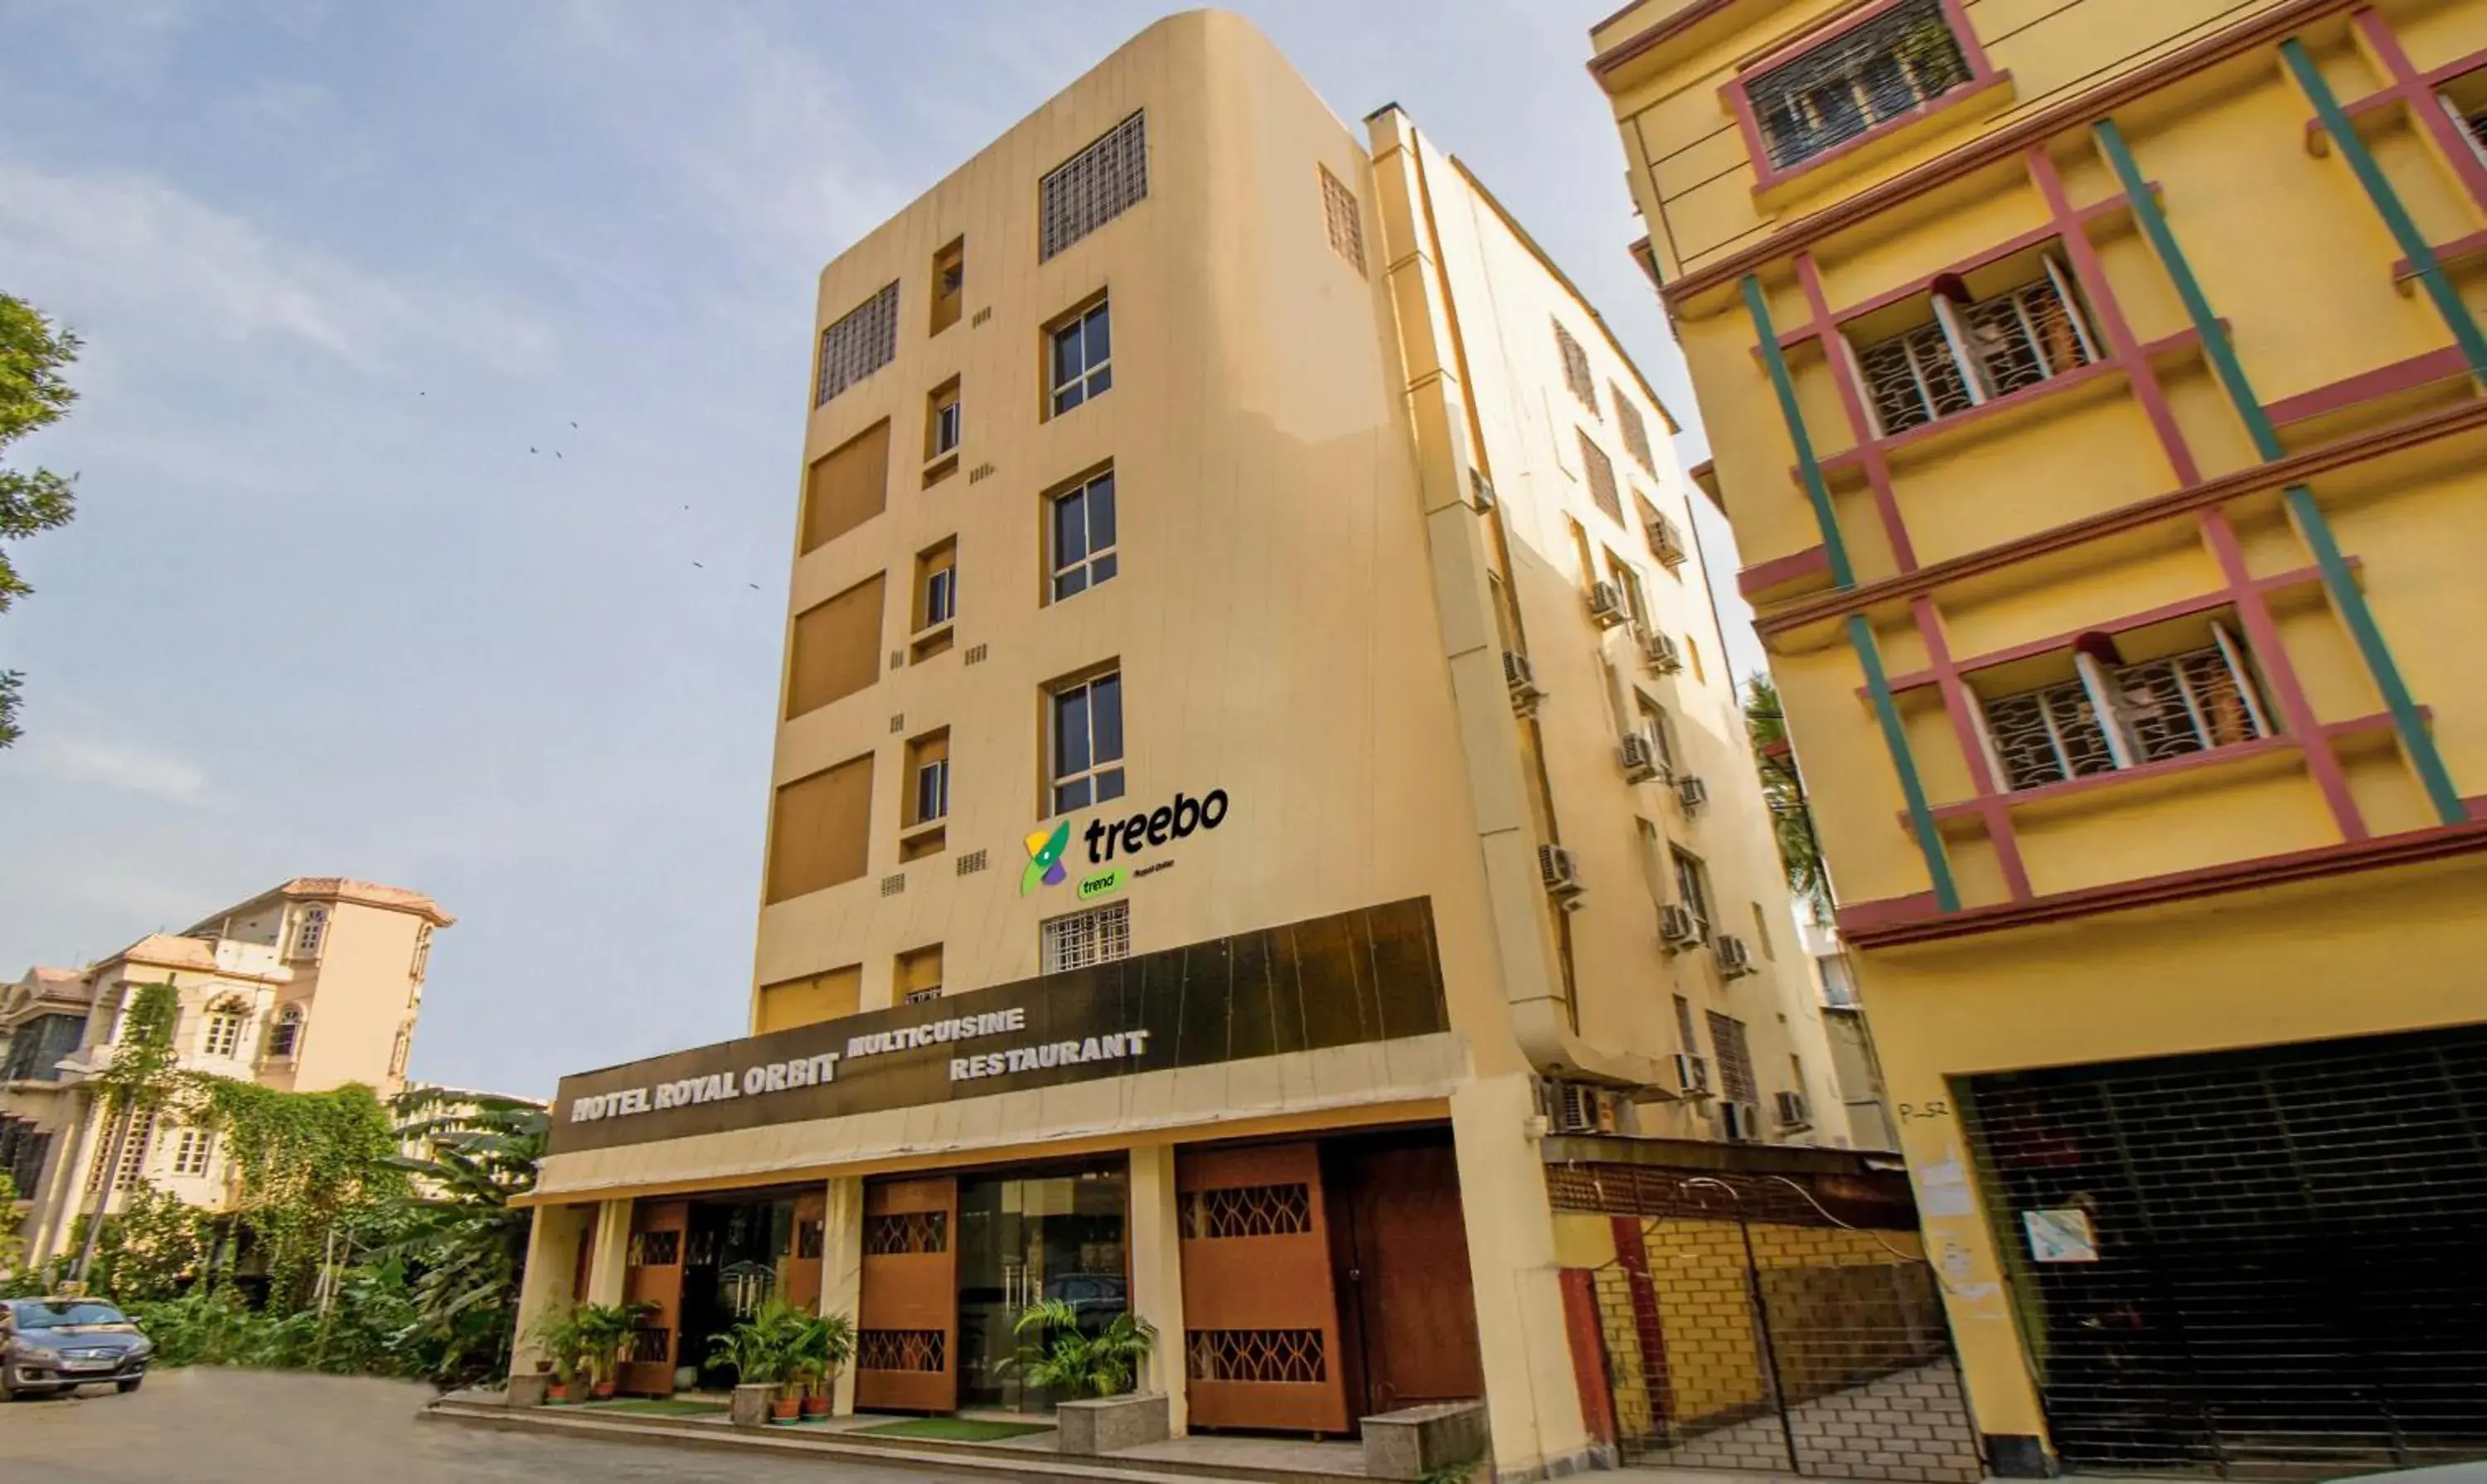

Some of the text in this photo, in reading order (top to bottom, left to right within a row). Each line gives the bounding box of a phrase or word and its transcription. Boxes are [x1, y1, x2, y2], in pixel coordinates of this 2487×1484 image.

[1084, 788, 1229, 864] treebo
[1084, 872, 1115, 894] trend
[847, 1007, 1025, 1058] MULTICUISINE
[950, 1030, 1149, 1081] RESTAURANT
[570, 1052, 841, 1123] HOTEL ROYAL ORBIT
